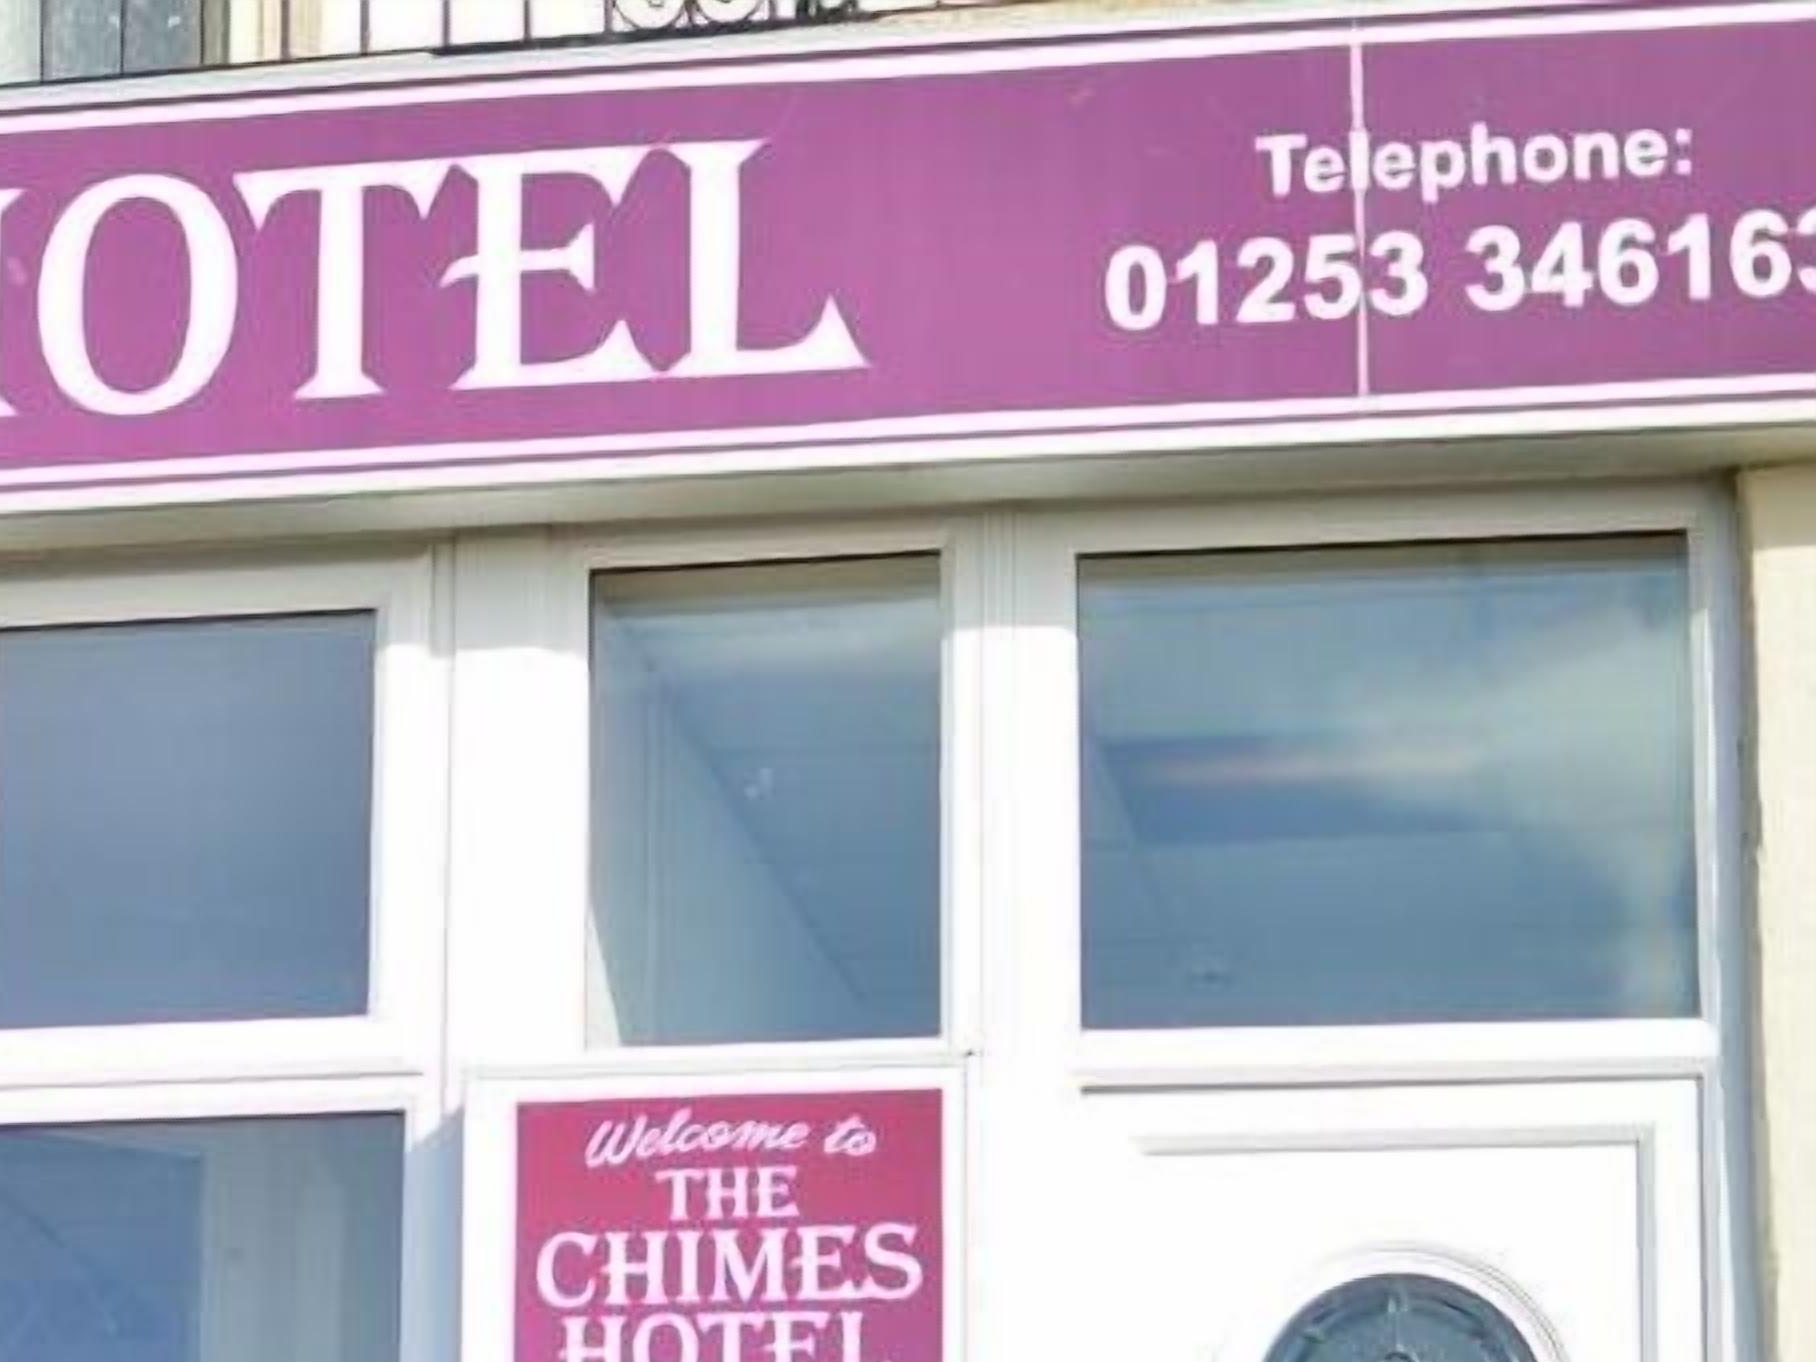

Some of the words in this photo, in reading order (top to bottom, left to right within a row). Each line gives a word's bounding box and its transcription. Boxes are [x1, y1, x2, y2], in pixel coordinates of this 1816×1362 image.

[1255, 122, 1692, 203] Telephone:
[1104, 230, 1429, 331] 01253
[584, 1108, 811, 1169] Welcome
[823, 1115, 878, 1157] to
[655, 1165, 801, 1221] THE
[535, 1222, 924, 1309] CHIMES
